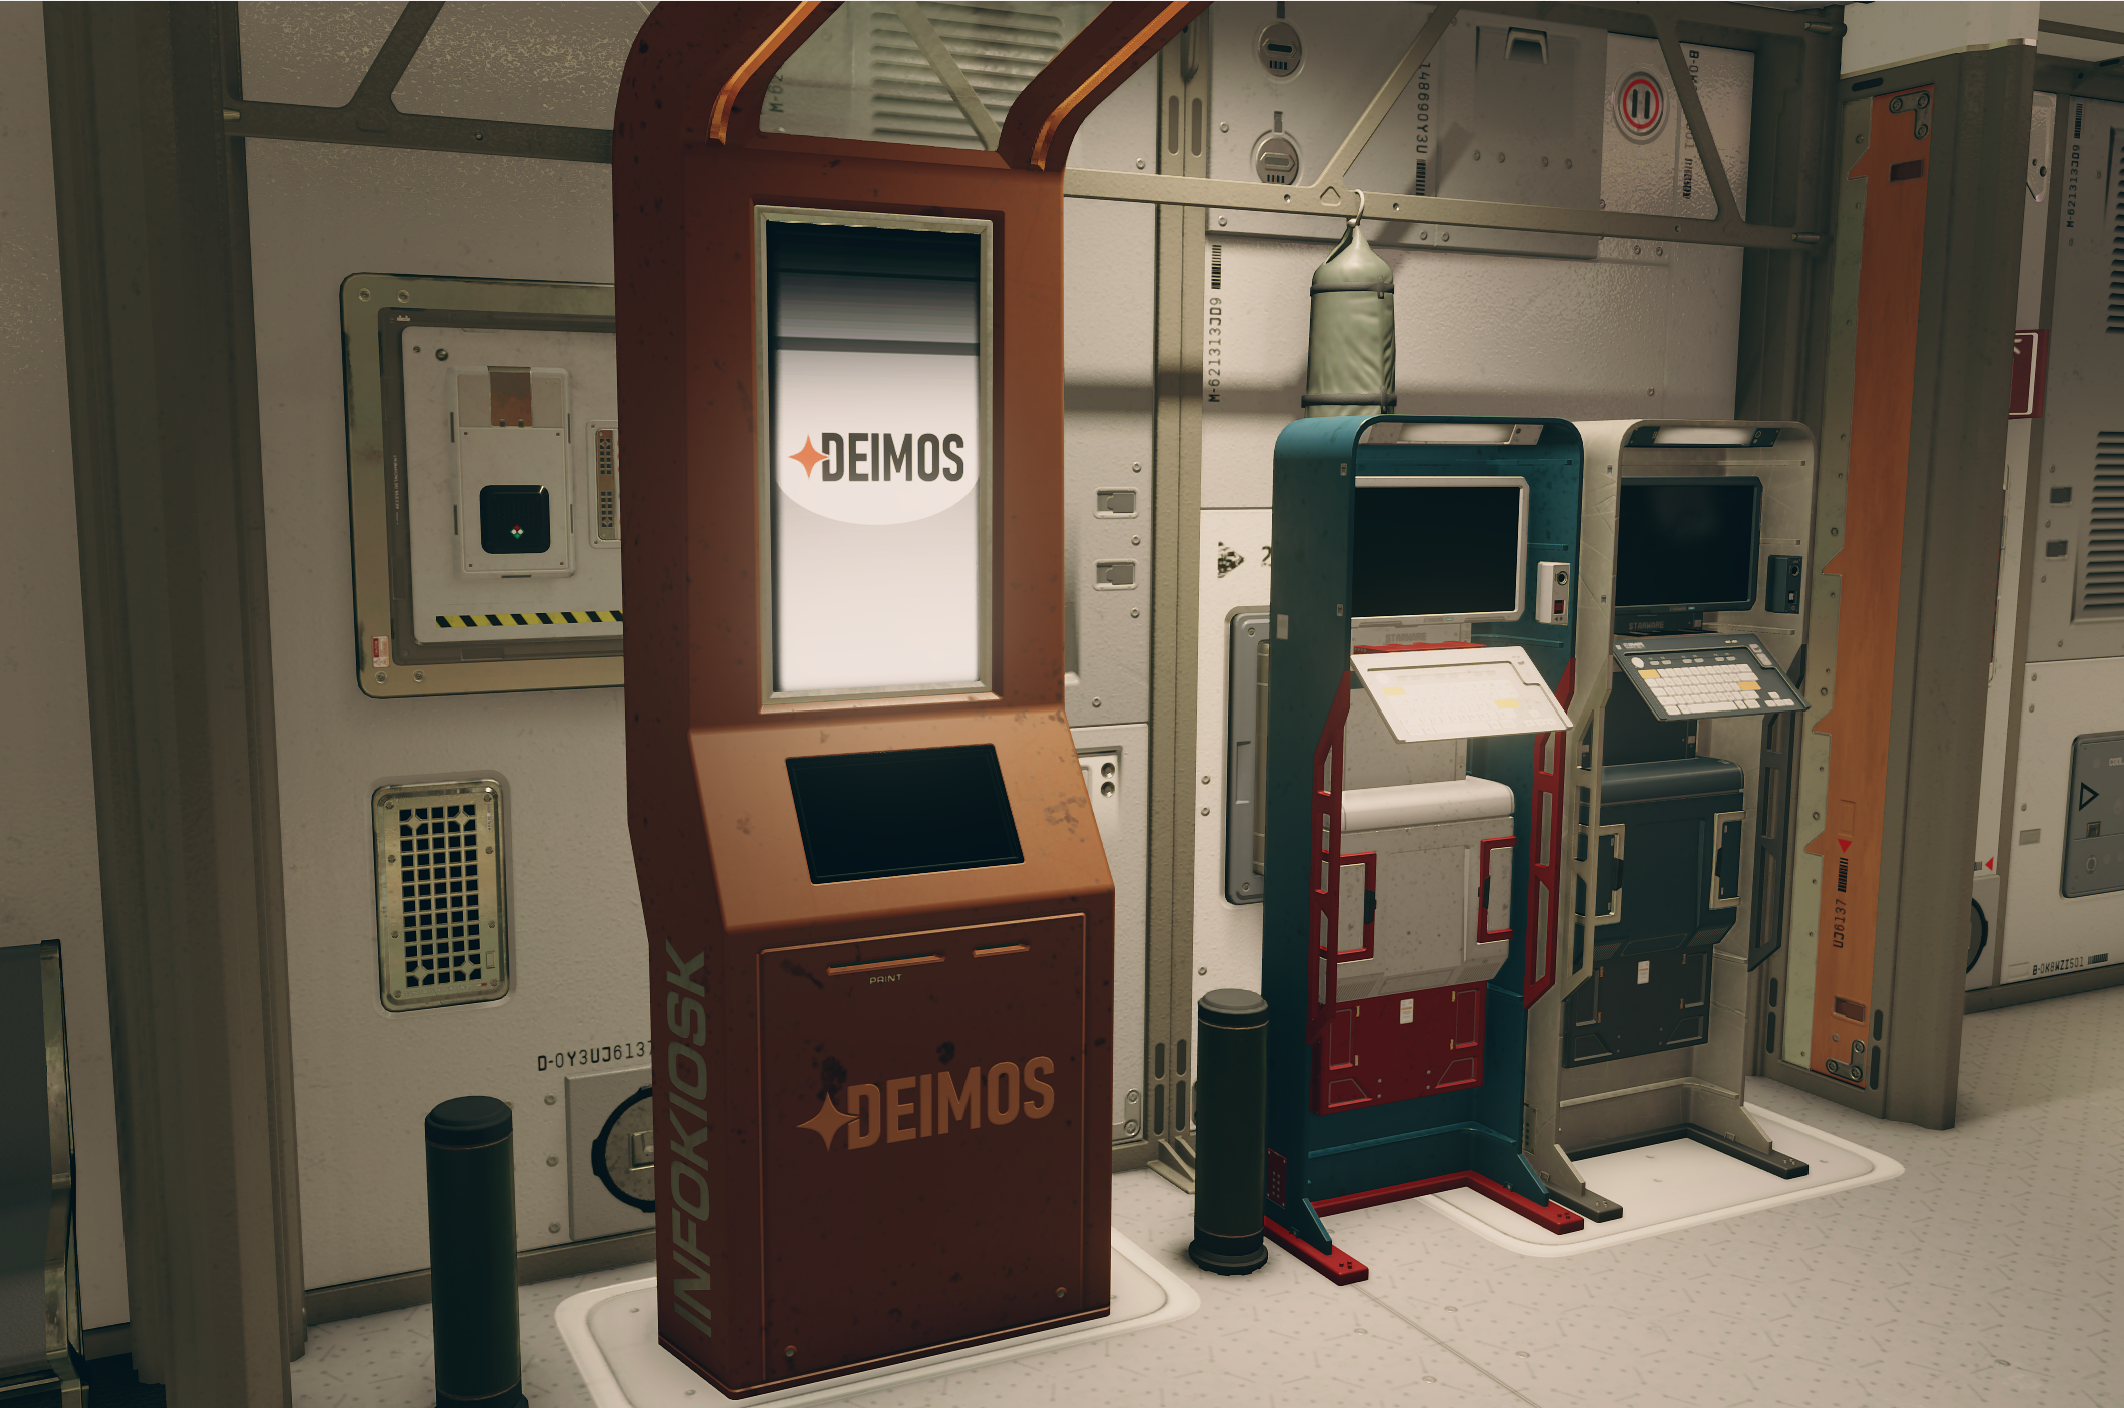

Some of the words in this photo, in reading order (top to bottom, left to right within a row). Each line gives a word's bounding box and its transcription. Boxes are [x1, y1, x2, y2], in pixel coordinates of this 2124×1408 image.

[1208, 297, 1222, 403] M-621313JD9
[822, 432, 964, 483] DEIMOS
[1385, 632, 1427, 644] STARWARE
[1629, 620, 1665, 630] STARWARE
[1832, 898, 1847, 949] UJ6137
[869, 973, 903, 985] PRINT
[537, 1041, 652, 1071] D-0Y3UJ613
[847, 1055, 1056, 1151] DEIMOS
[665, 938, 713, 1338] INFOKIOSK
